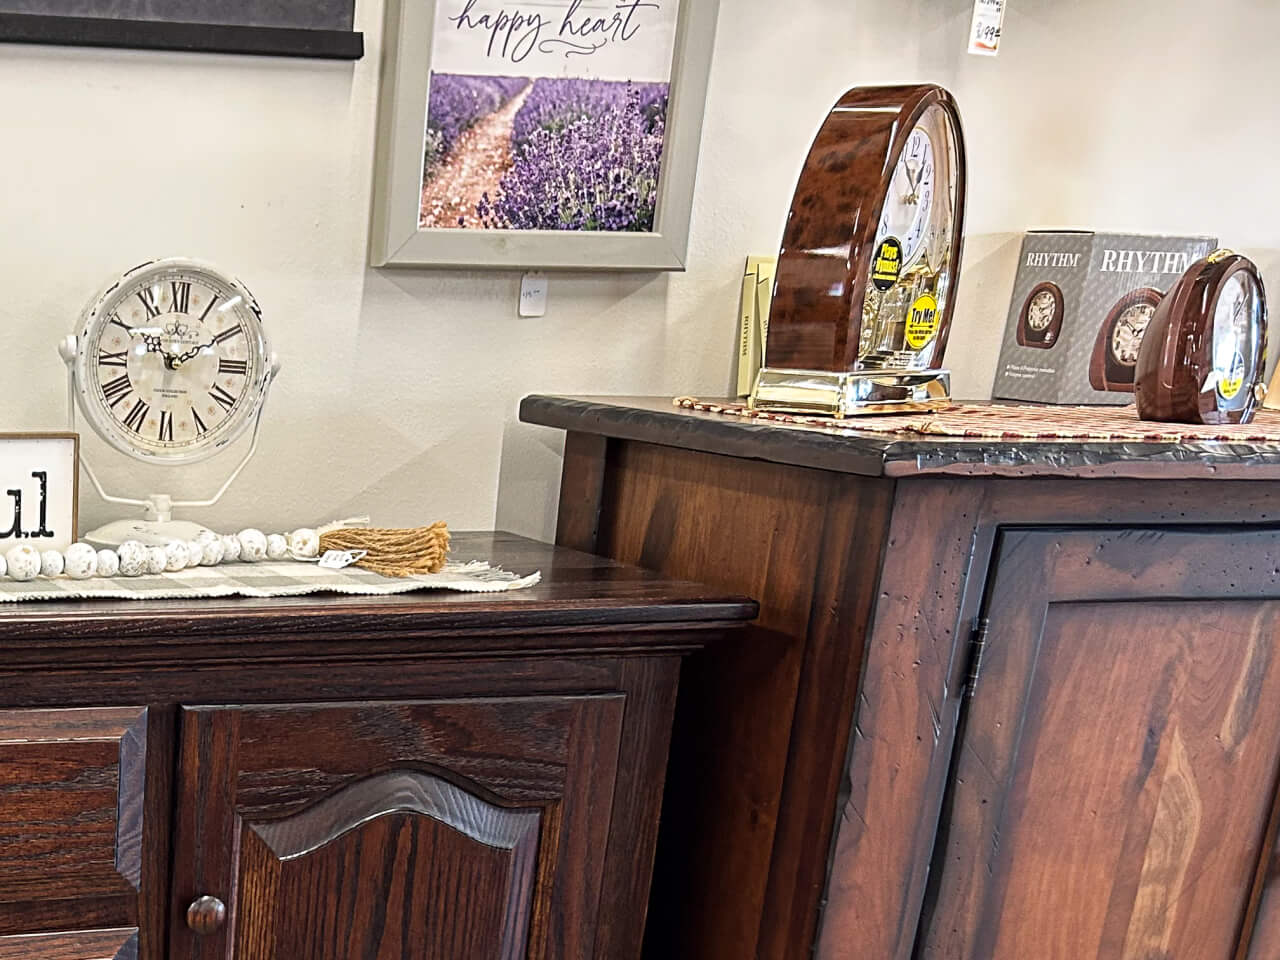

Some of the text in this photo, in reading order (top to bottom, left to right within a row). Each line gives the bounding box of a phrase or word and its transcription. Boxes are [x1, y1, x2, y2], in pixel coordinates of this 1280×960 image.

[448, 0, 659, 63] happy heart
[1026, 252, 1078, 268] RHYTHM
[911, 308, 936, 324] Try Me!
